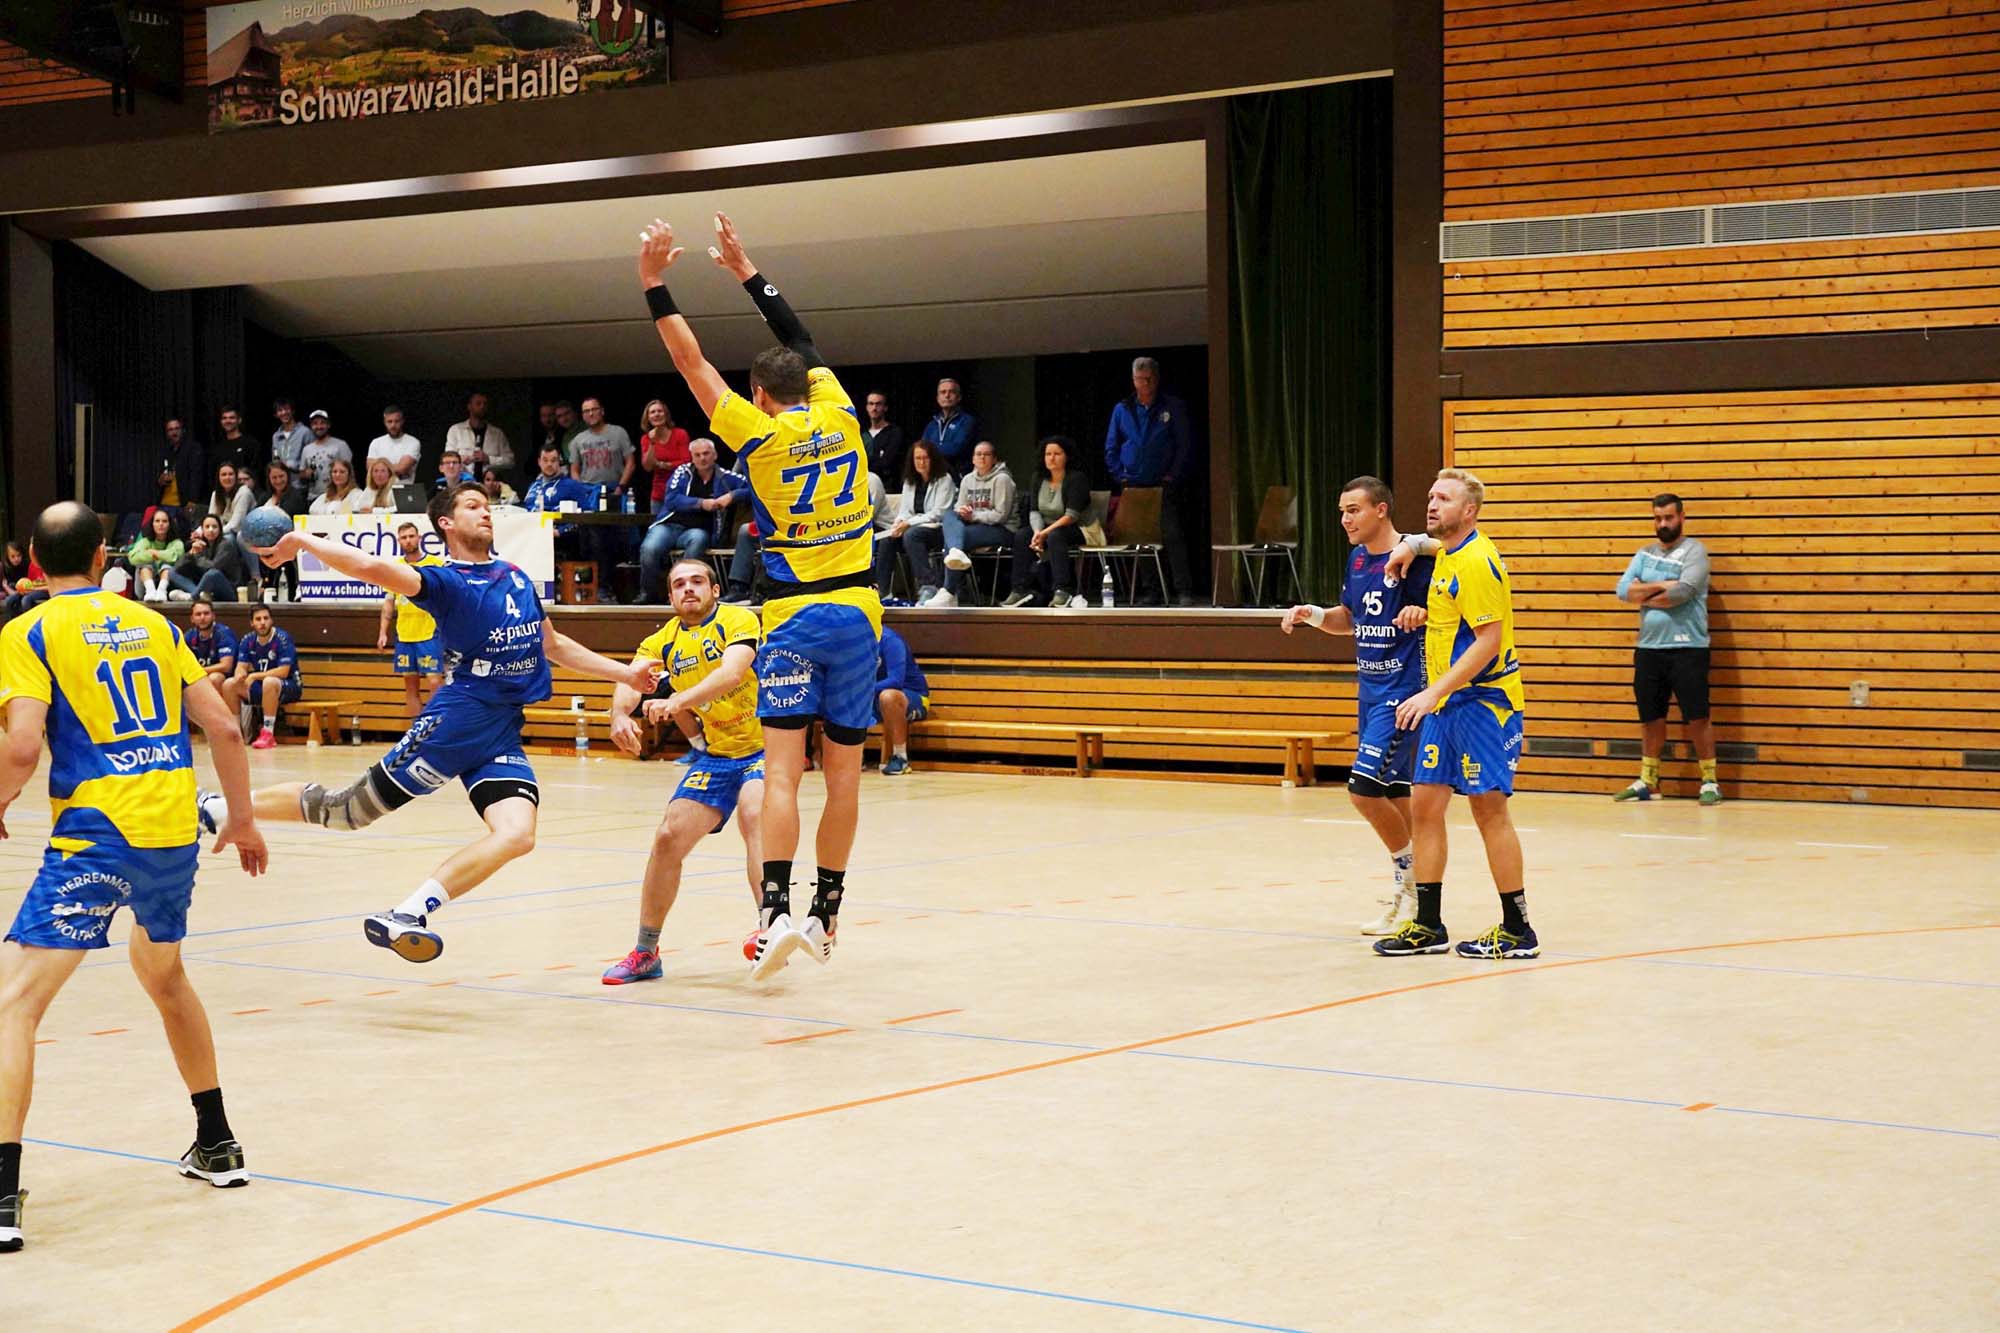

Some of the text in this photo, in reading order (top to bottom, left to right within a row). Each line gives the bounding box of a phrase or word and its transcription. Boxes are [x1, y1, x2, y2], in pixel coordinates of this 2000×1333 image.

[283, 0, 418, 19] Herzlich Willkomme
[279, 58, 579, 124] Schwarzwald-Halle
[781, 450, 858, 516] 77
[505, 593, 521, 618] 4
[1362, 591, 1384, 617] 15
[1362, 625, 1395, 639] pixum
[258, 658, 269, 672] 17
[397, 655, 409, 667] 31
[1359, 657, 1404, 671] SCHNEBEL
[96, 657, 168, 737] 10
[766, 686, 809, 709] WOLFACH
[1422, 744, 1439, 768] 3
[683, 771, 711, 790] 21
